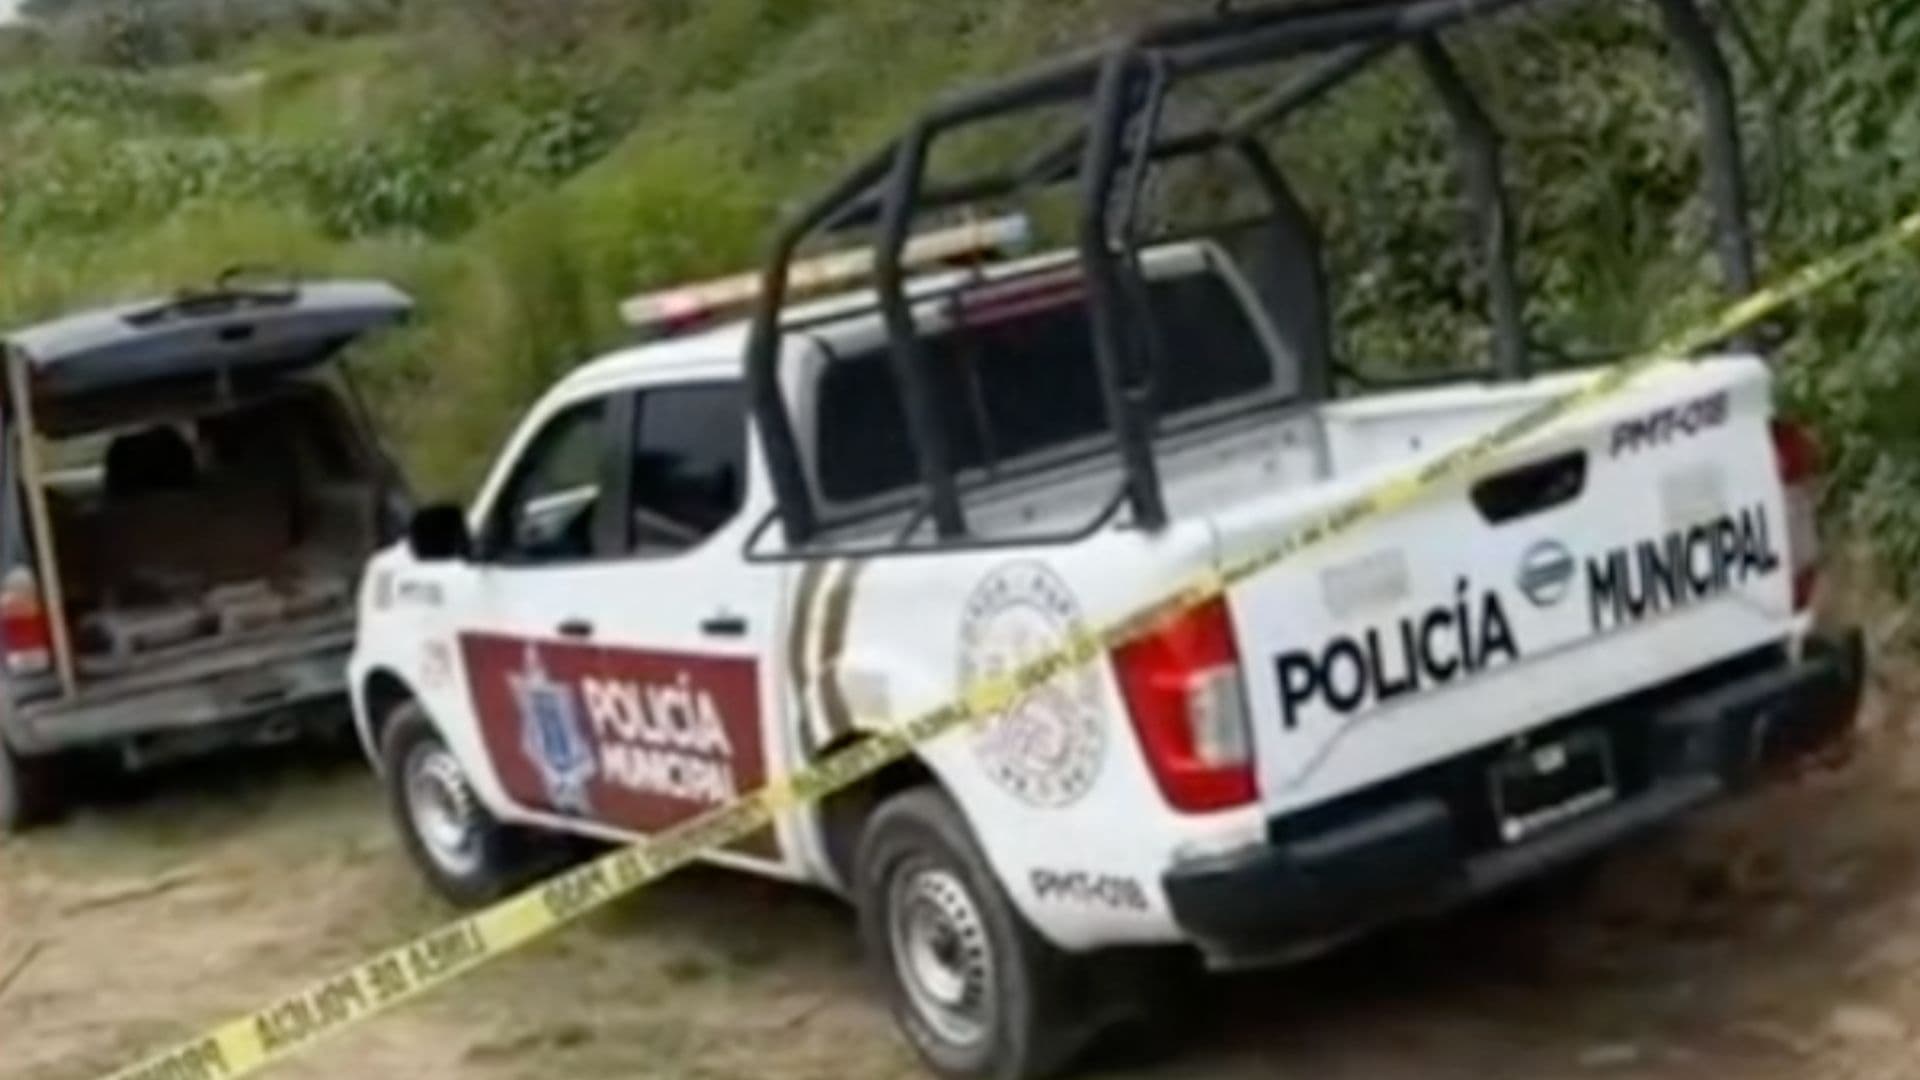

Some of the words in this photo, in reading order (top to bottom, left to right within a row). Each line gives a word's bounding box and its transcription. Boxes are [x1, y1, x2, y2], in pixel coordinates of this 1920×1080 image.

[1273, 577, 1519, 729] POLICÍA
[1584, 503, 1779, 634] MUNICIPAL
[580, 669, 735, 756] POLICÍA
[600, 743, 740, 804] MUNICIPAL
